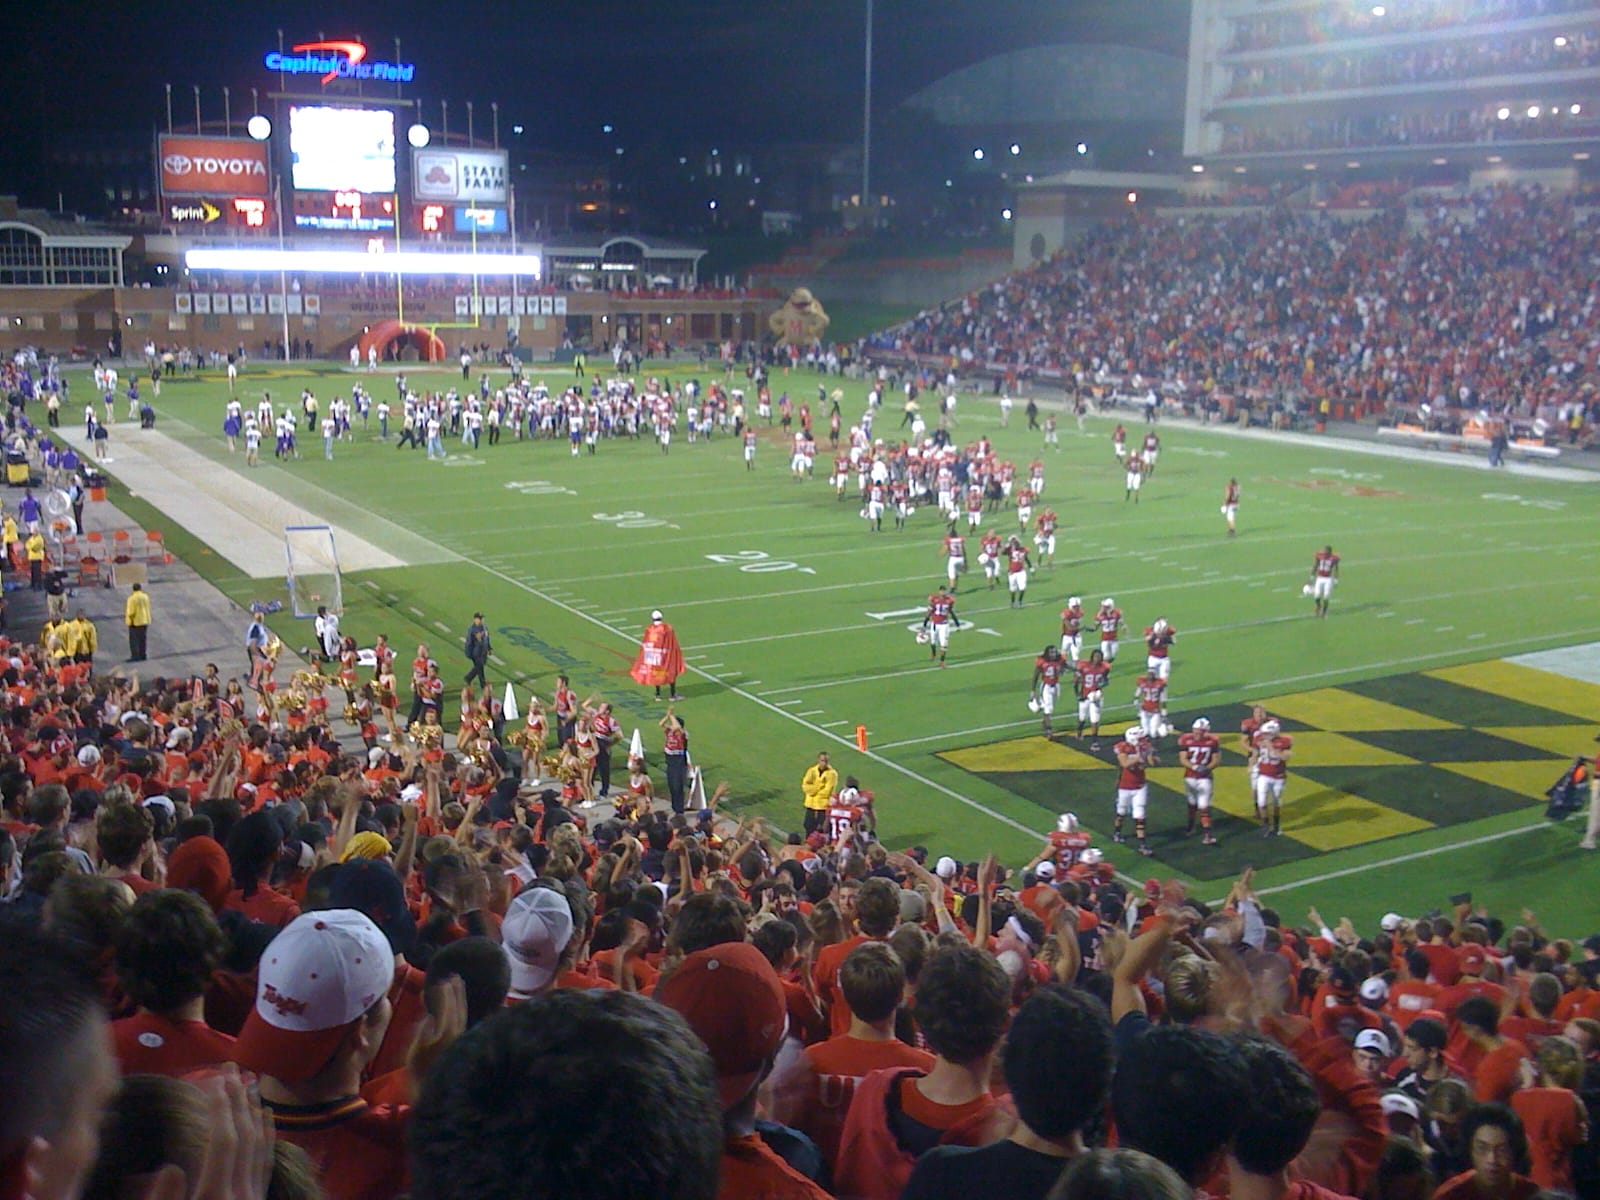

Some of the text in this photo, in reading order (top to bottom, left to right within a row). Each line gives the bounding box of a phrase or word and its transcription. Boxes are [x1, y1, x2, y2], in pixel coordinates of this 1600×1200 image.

[264, 51, 337, 74] Capital
[373, 61, 415, 82] Field
[192, 157, 266, 176] TOYOTA
[463, 165, 504, 177] STATE
[464, 178, 505, 190] FARM
[171, 205, 205, 222] Sprint
[1188, 746, 1212, 765] 77
